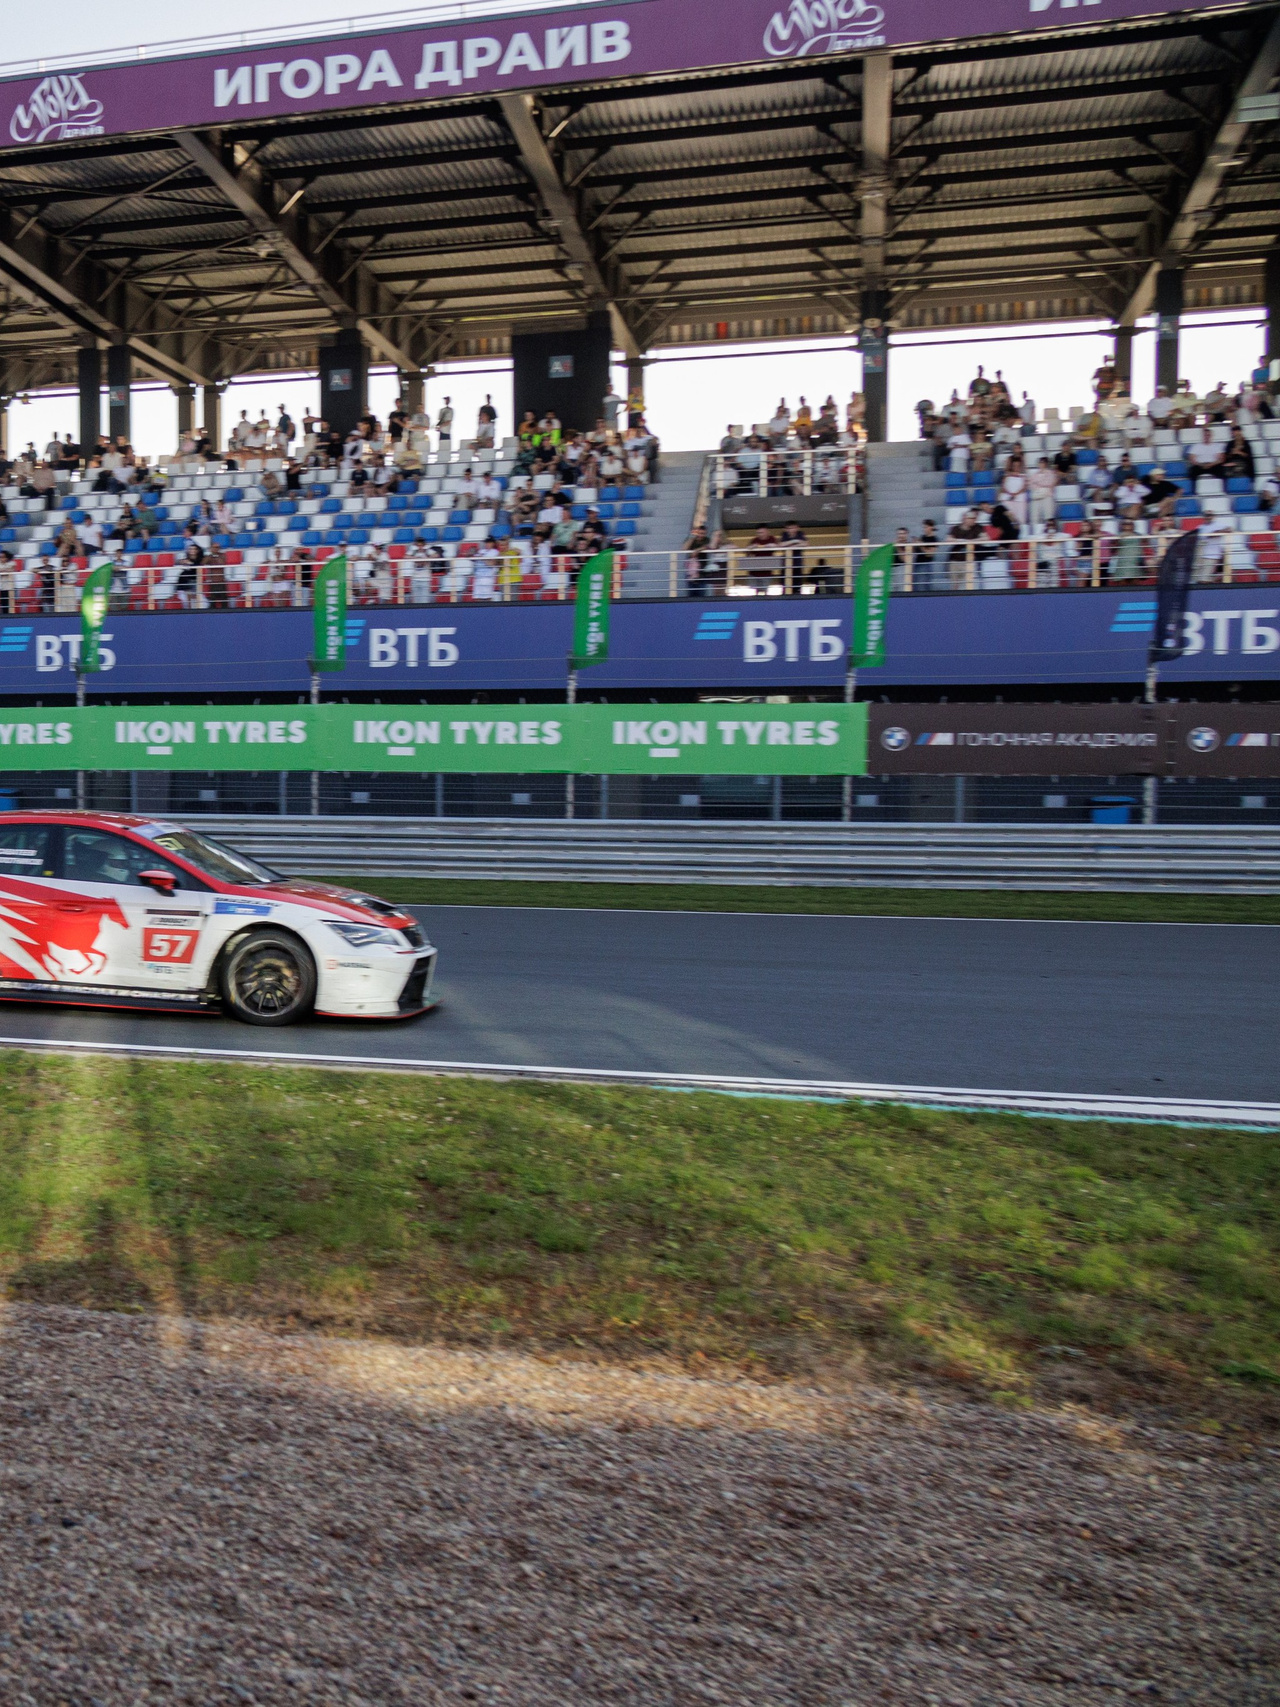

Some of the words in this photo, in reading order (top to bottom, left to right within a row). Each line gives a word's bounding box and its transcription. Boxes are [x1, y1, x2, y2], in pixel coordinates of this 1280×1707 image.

[214, 49, 402, 107] ИГОРА
[415, 20, 631, 90] ДРАЙВ
[369, 627, 460, 668] ВТБ
[743, 619, 844, 663] ВТБ
[115, 721, 195, 749] IKON
[203, 721, 307, 744] TYRES
[353, 721, 440, 749] IKON
[449, 721, 562, 745] TYRES
[612, 721, 707, 749] IKON
[717, 721, 840, 746] TYRES
[1054, 733, 1157, 749] АКАДЕМИЯ
[149, 934, 192, 957] 57
